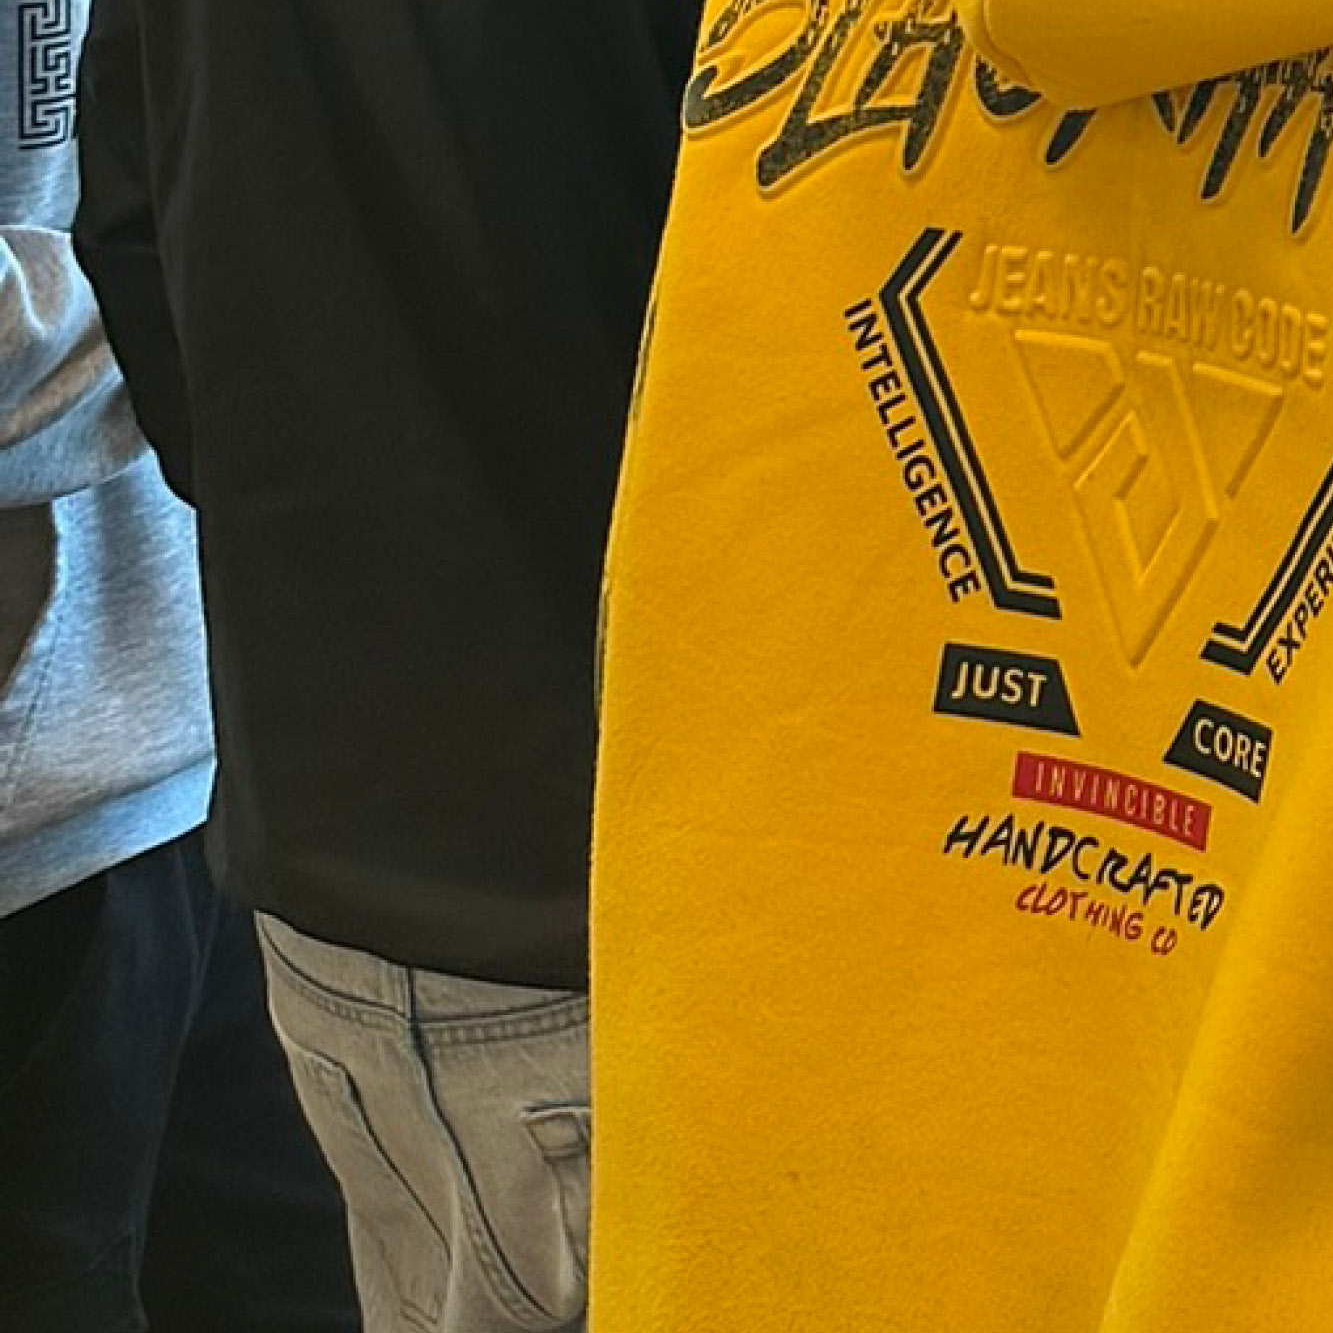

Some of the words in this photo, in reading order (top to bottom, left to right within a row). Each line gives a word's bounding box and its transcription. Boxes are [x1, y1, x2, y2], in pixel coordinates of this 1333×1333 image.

[967, 243, 1130, 330] JEANS
[1230, 287, 1330, 390] CODE
[844, 299, 980, 603] INTELLIGENCE
[951, 661, 1047, 708] JUST
[1194, 717, 1267, 779] CORE
[1034, 762, 1196, 837] INVINCIBLE
[943, 814, 1225, 930] HANDCRAFTED
[1015, 883, 1144, 941] CLOTHING
